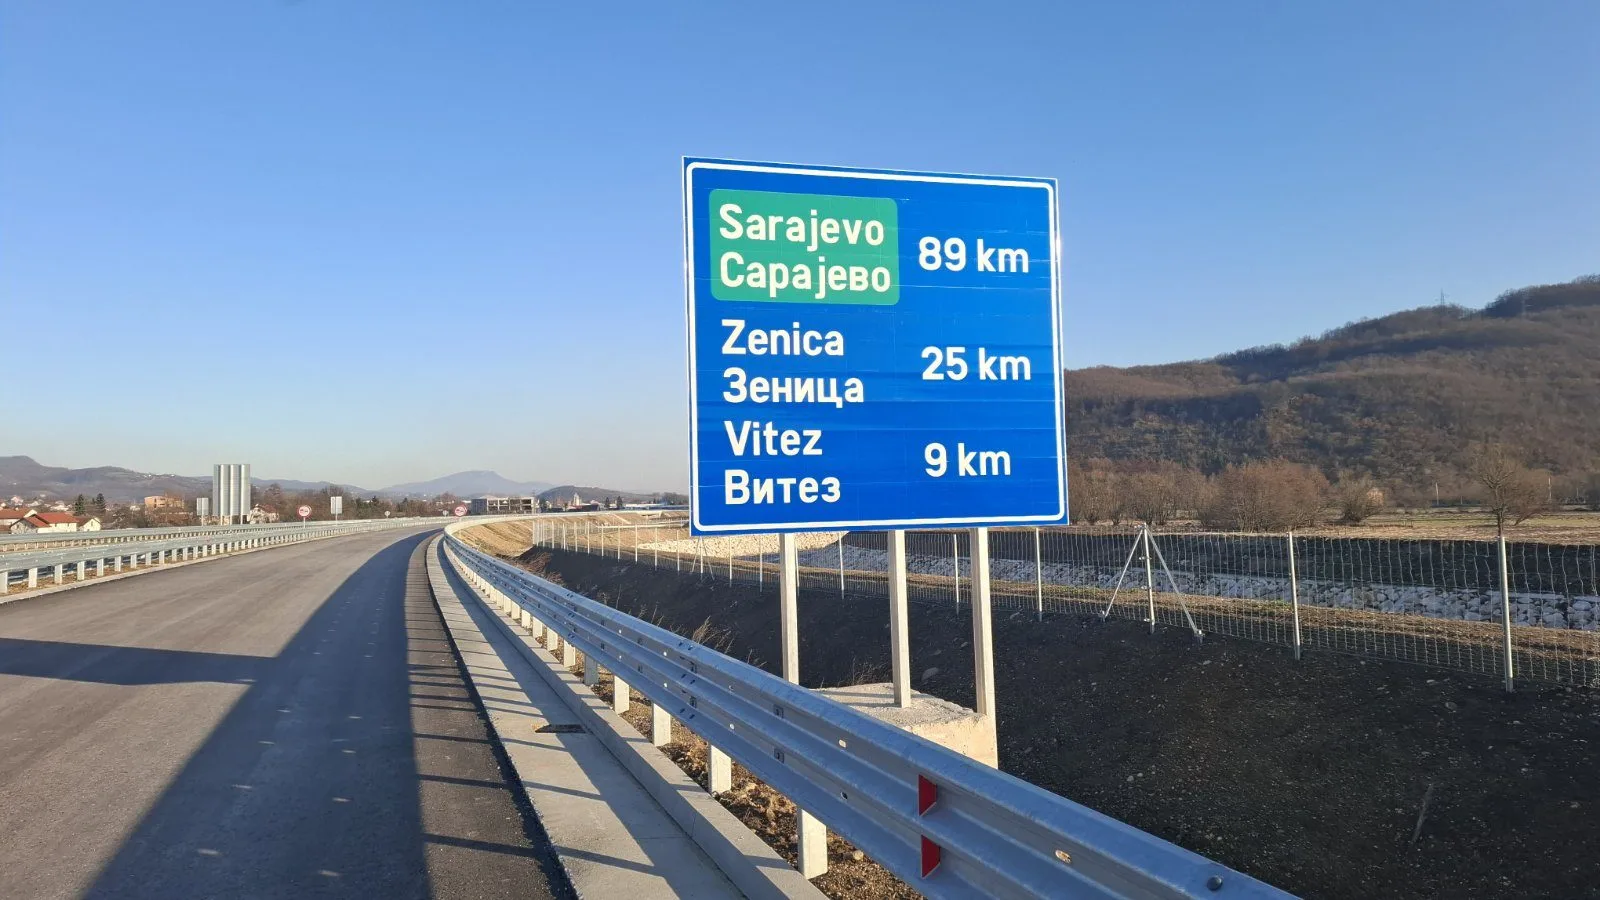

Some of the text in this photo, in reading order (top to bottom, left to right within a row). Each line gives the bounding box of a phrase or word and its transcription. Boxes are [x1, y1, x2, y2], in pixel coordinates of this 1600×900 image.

[720, 204, 884, 251] Sarajevo
[919, 237, 1028, 272] 89 km
[721, 252, 890, 299] Сарајево
[722, 320, 843, 355] Zenica
[922, 347, 1030, 380] 25 km
[724, 368, 863, 408] Зеница
[725, 421, 822, 455] Vitez
[925, 443, 1010, 477] 9 km
[725, 470, 840, 504] Витез
